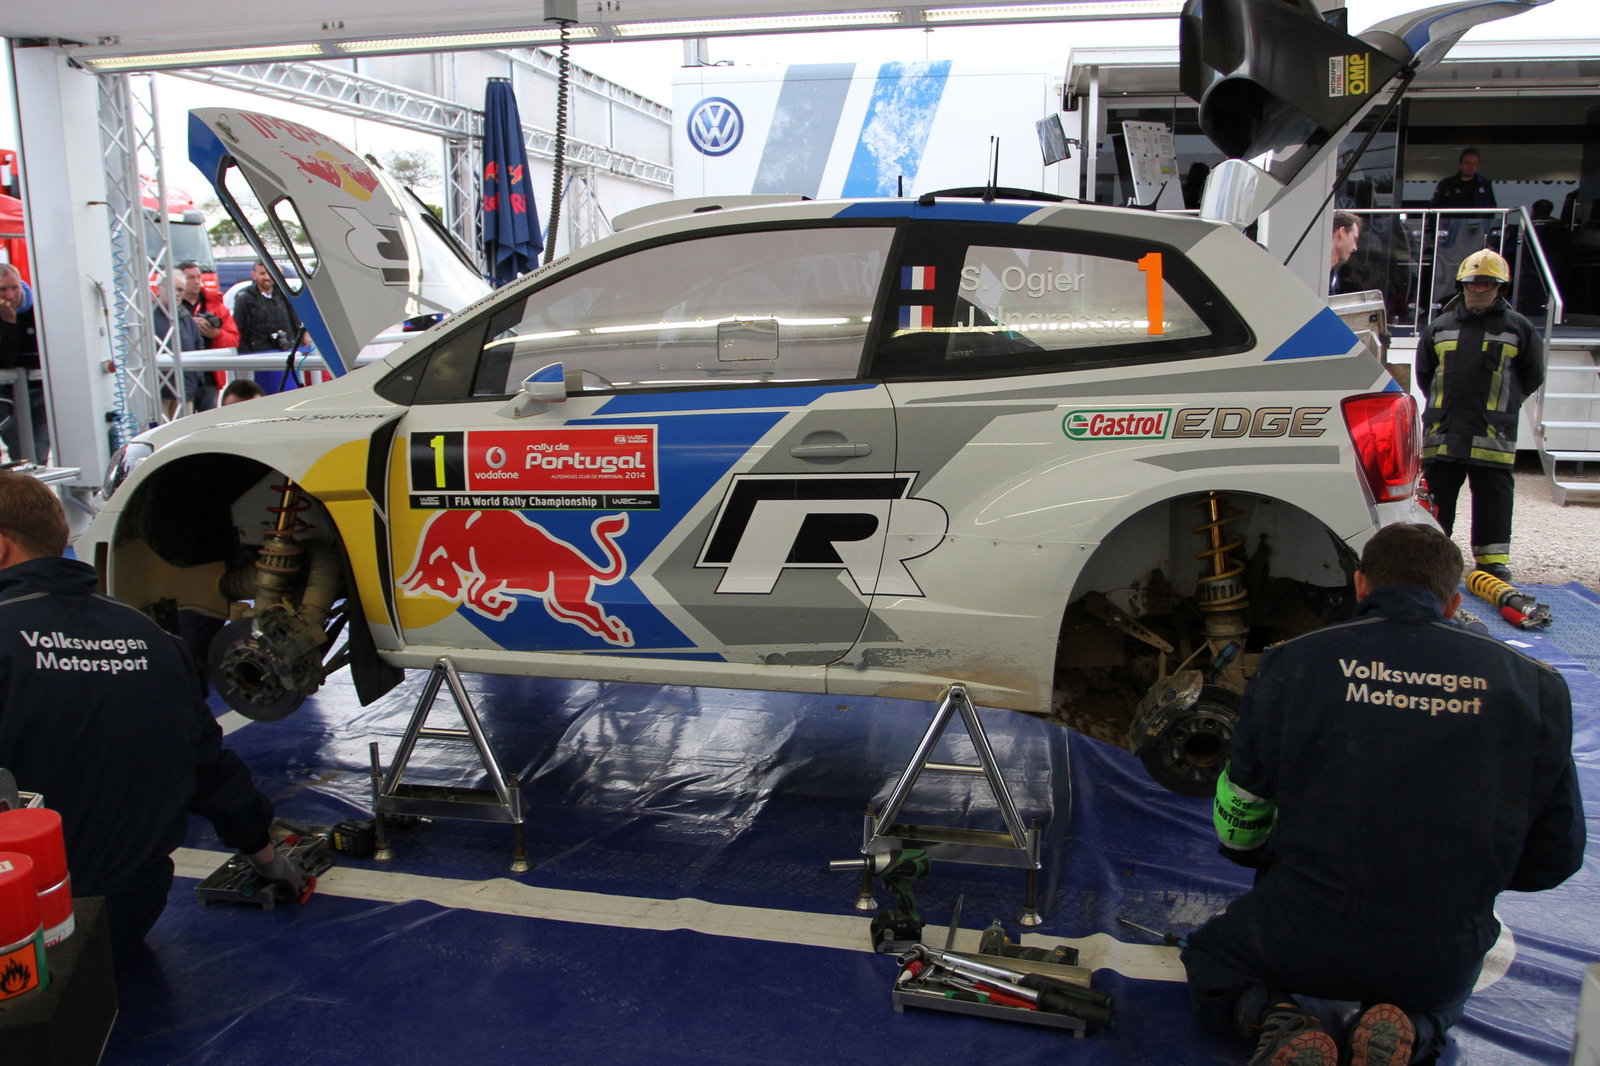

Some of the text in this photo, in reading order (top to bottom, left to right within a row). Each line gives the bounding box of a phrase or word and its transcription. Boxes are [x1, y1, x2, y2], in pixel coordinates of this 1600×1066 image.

[1349, 54, 1365, 95] OMP
[689, 99, 742, 154] VW
[434, 256, 570, 332] www.volkswagen-motorsport.com
[960, 266, 1086, 298] S. Ogier
[1138, 253, 1163, 335] 1
[958, 305, 1138, 338] J. Ingrassia
[307, 412, 386, 421] Services
[1089, 406, 1333, 439] Castrol EDGE
[430, 435, 446, 488] 1
[525, 451, 646, 473] Portugal
[526, 443, 570, 452] rally de
[475, 470, 519, 480] vodafone
[625, 471, 646, 479] 2014
[454, 496, 598, 508] FIA World Rally Championship
[693, 470, 950, 598] R
[19, 630, 148, 655] Volkswagen
[36, 651, 148, 675] Motorsport
[1338, 658, 1488, 693] Volkswagen
[1345, 682, 1481, 717] Motorsport
[1227, 828, 1236, 841] 1
